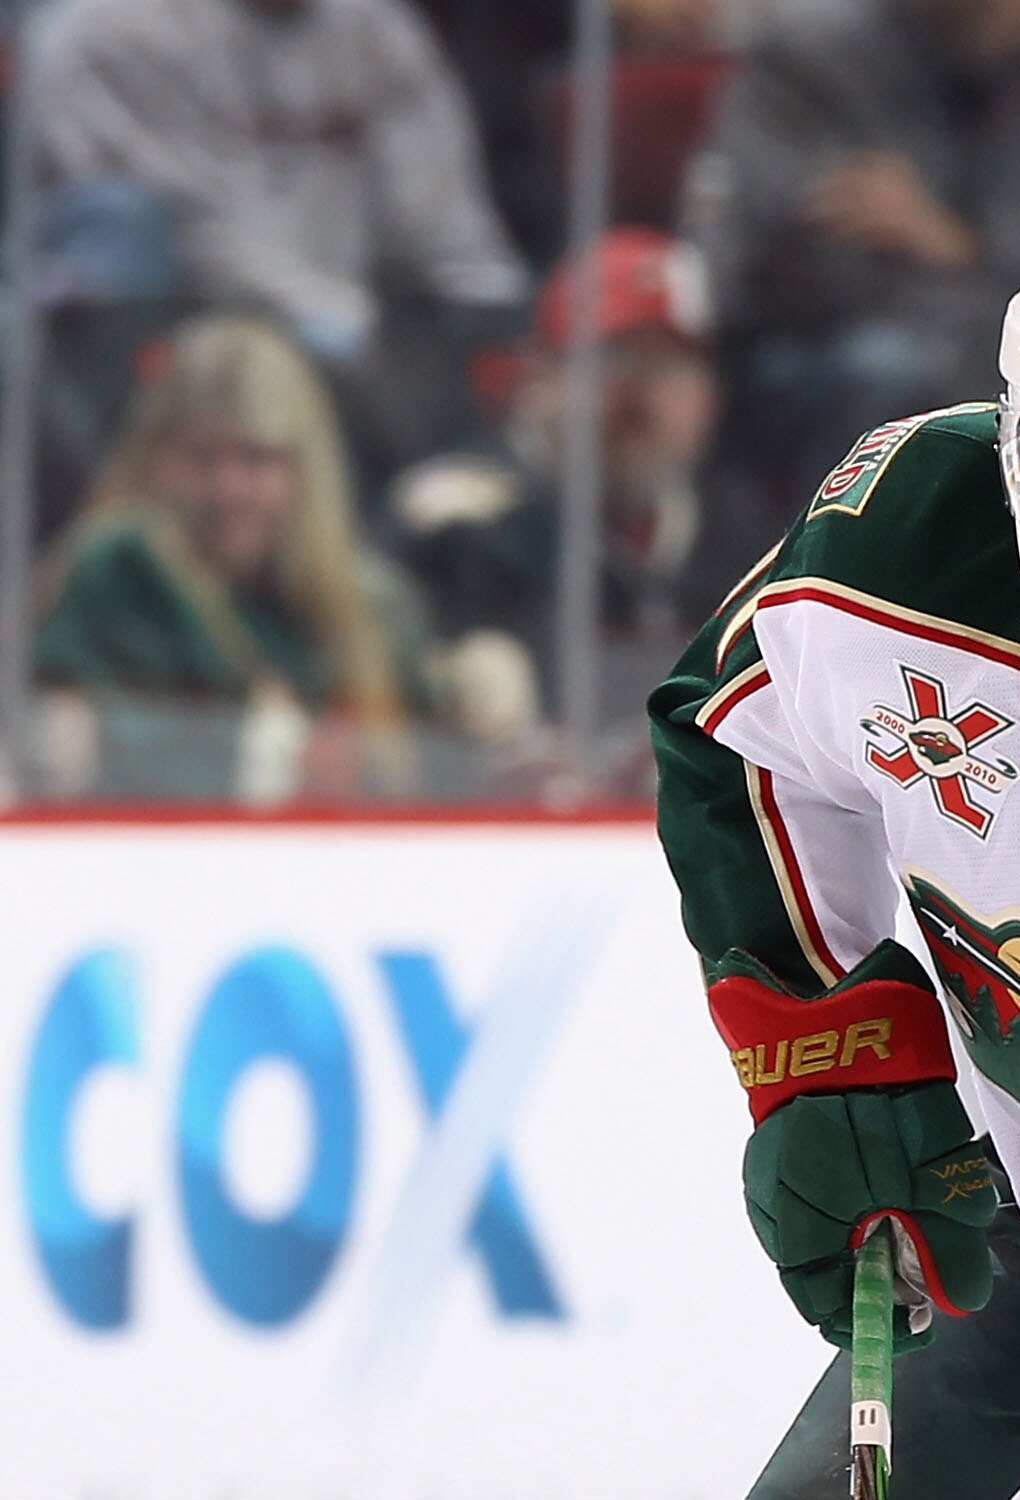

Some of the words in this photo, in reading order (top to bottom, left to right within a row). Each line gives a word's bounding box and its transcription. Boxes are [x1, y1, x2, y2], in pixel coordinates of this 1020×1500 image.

[875, 710, 907, 735] 2000
[964, 760, 997, 786] 2010
[18, 943, 568, 1332] COX
